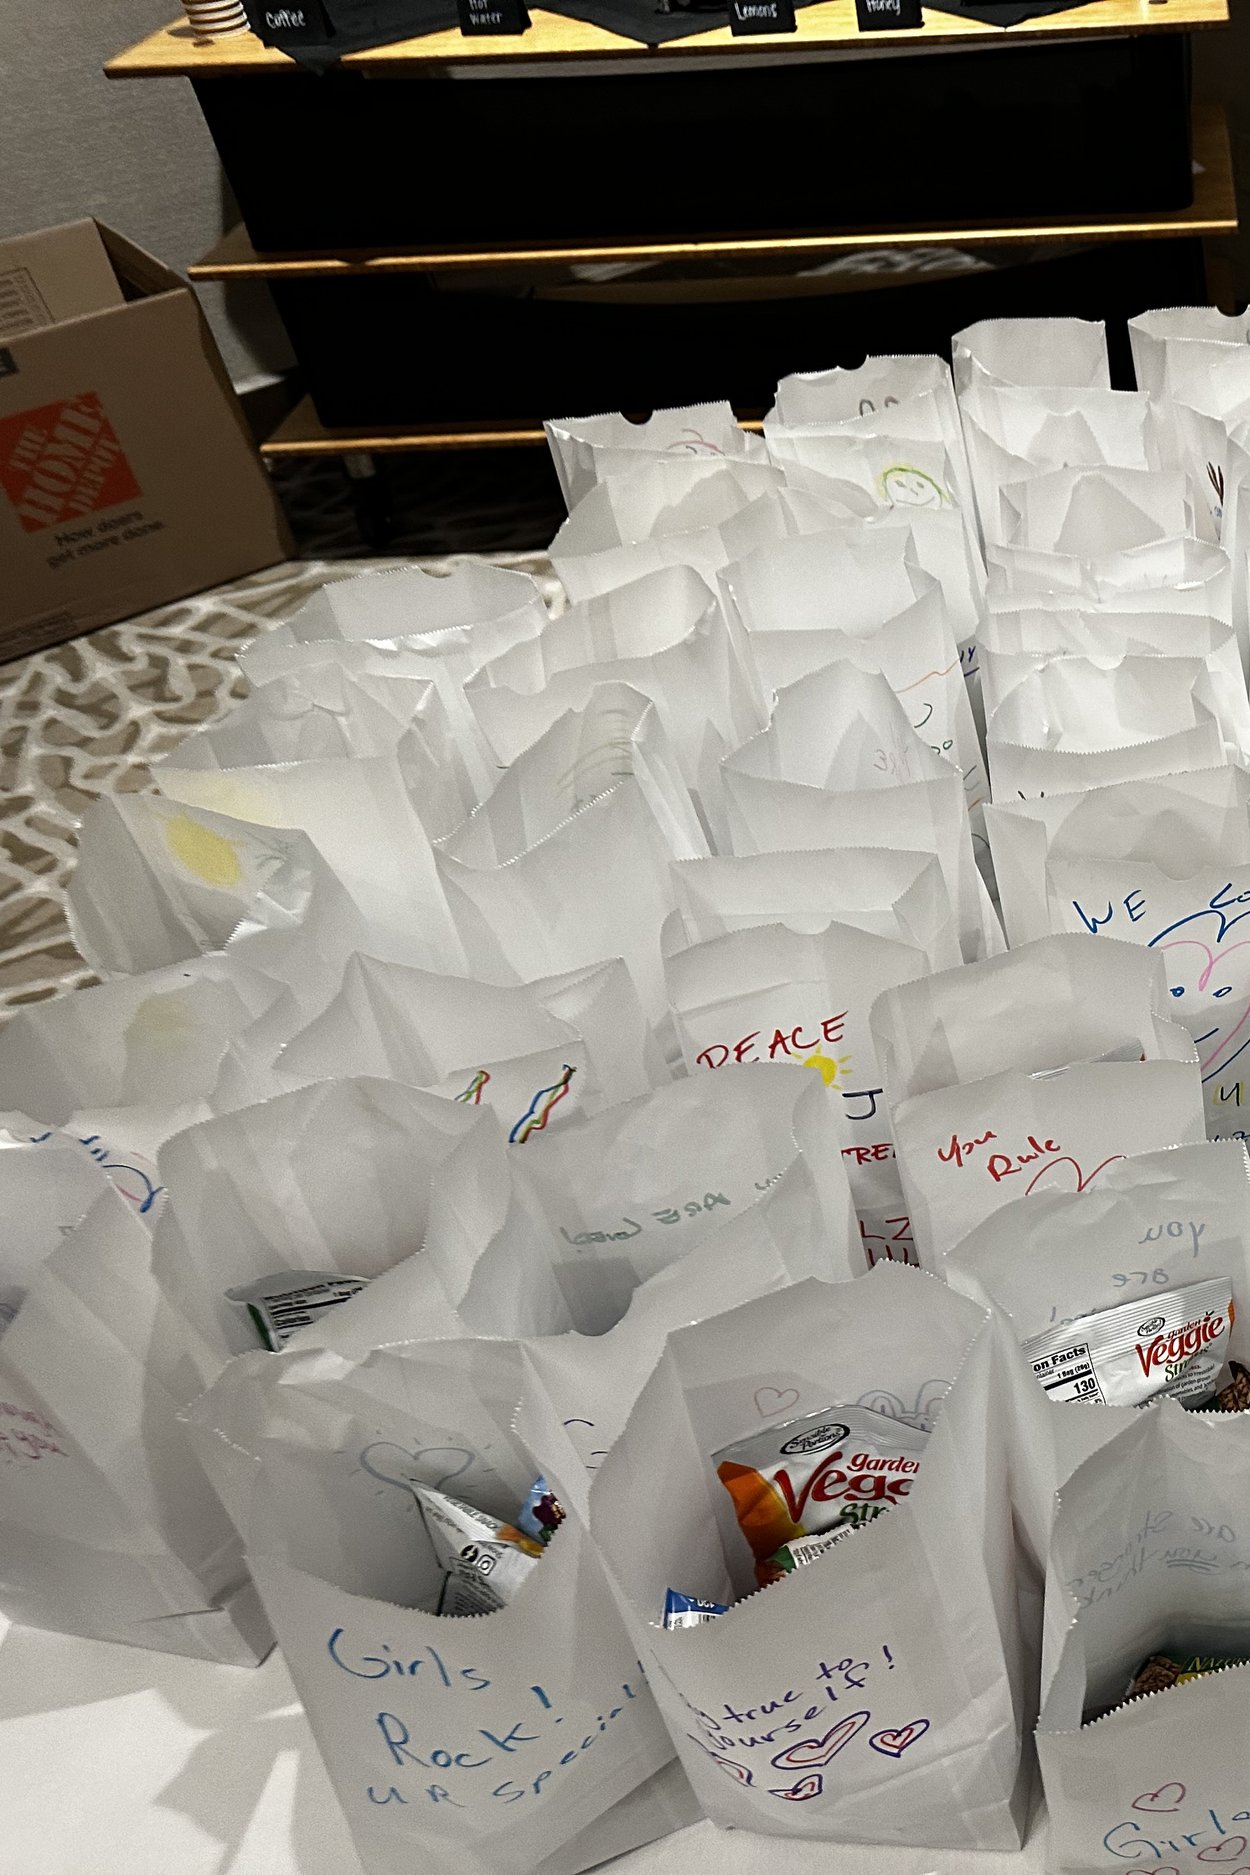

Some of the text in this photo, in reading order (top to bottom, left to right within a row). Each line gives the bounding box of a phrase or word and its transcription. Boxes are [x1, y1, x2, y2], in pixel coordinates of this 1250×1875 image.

[265, 8, 307, 29] Coffee
[734, 2, 778, 22] Lemons
[18, 401, 103, 526] HOME
[1073, 889, 1146, 933] WE
[1051, 1347, 1087, 1365] Facts
[1135, 1316, 1226, 1378] Veggie
[1073, 1377, 1096, 1395] 130
[839, 1502, 891, 1525] Str
[327, 1627, 491, 1690] Girls
[723, 1689, 803, 1723] true
[375, 1685, 564, 1768] Rock!
